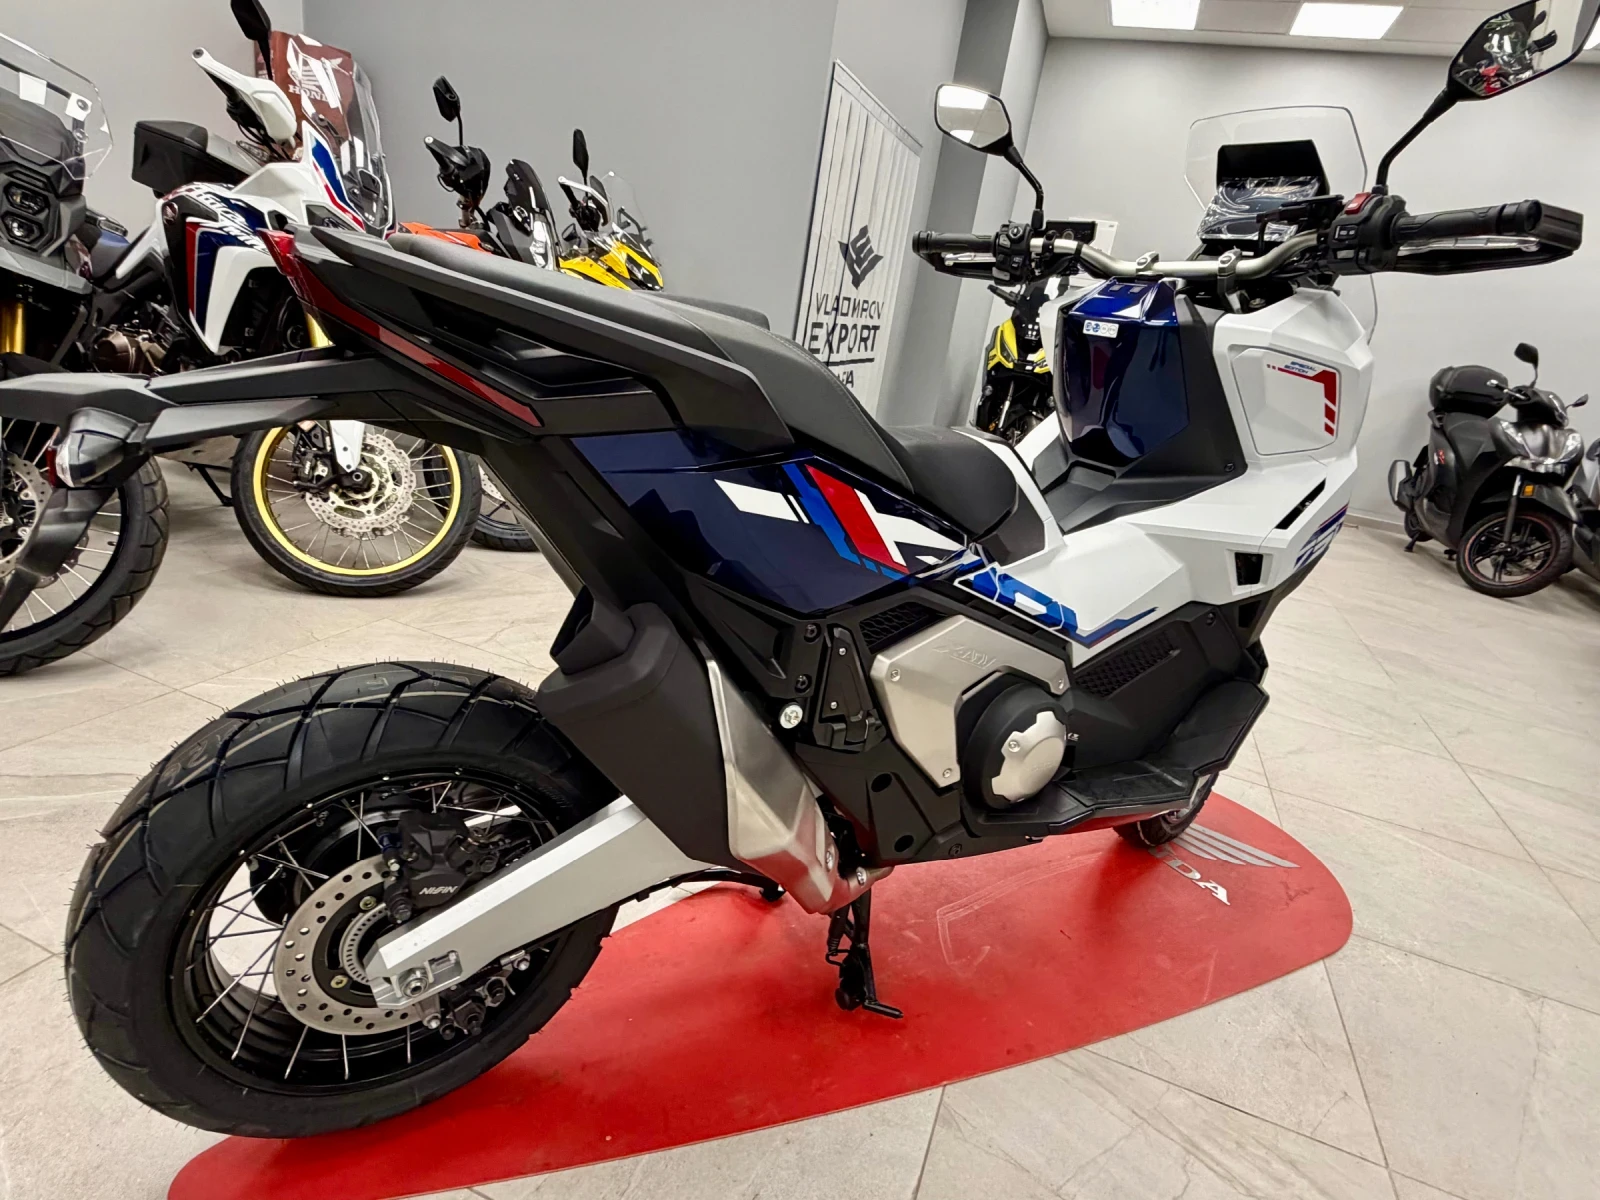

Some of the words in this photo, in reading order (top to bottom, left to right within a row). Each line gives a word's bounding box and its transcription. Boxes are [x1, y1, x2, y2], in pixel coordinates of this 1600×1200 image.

[288, 84, 328, 101] HON
[808, 322, 880, 354] EXPORT
[418, 885, 459, 895] NISSIN
